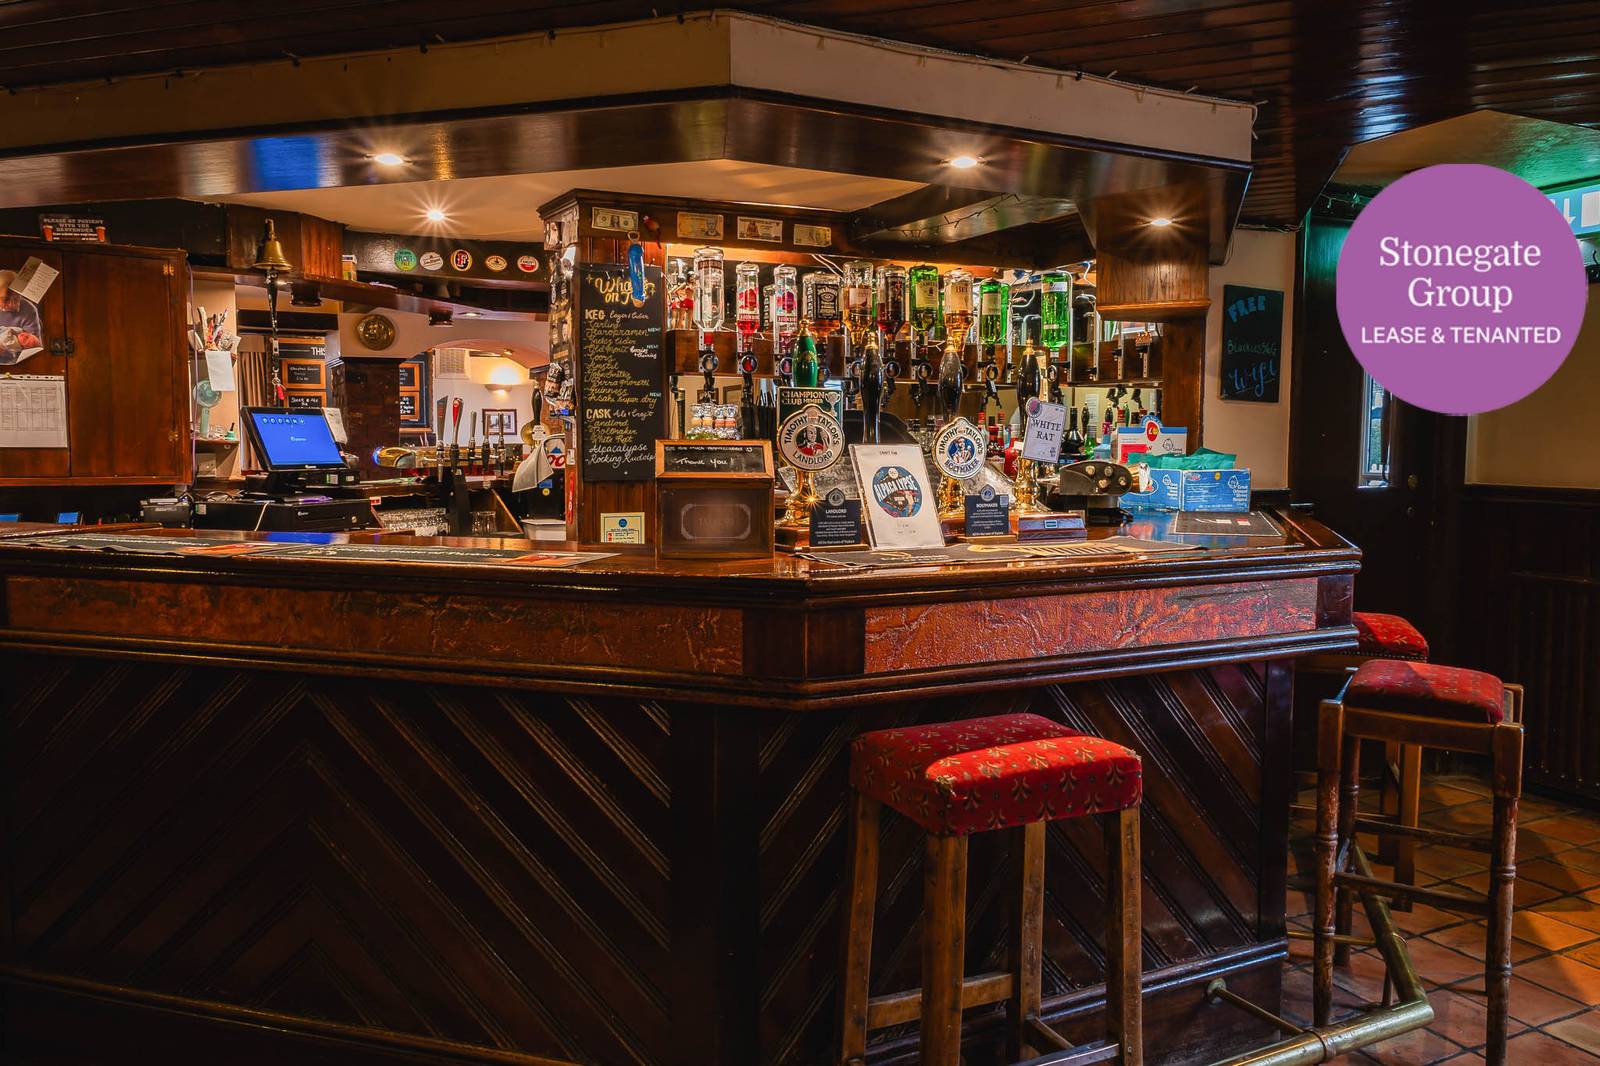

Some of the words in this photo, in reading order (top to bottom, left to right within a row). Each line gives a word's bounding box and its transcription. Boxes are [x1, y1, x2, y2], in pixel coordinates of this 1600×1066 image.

[605, 292, 619, 303] on
[585, 309, 606, 320] KEG
[1227, 295, 1266, 323] FREE
[586, 408, 611, 419] CASK
[784, 415, 808, 445] TIMOTHY
[817, 415, 840, 445] TAYLOR'S
[1032, 418, 1061, 432] WHITE
[938, 428, 959, 455] TIMOTHY
[964, 428, 984, 455] TAYLOR'S
[1035, 430, 1056, 442] RAT
[622, 453, 656, 463] Rudolp
[675, 457, 705, 465] Thank
[792, 450, 833, 465] LANDLORD
[944, 459, 978, 474] BOLTMAKER
